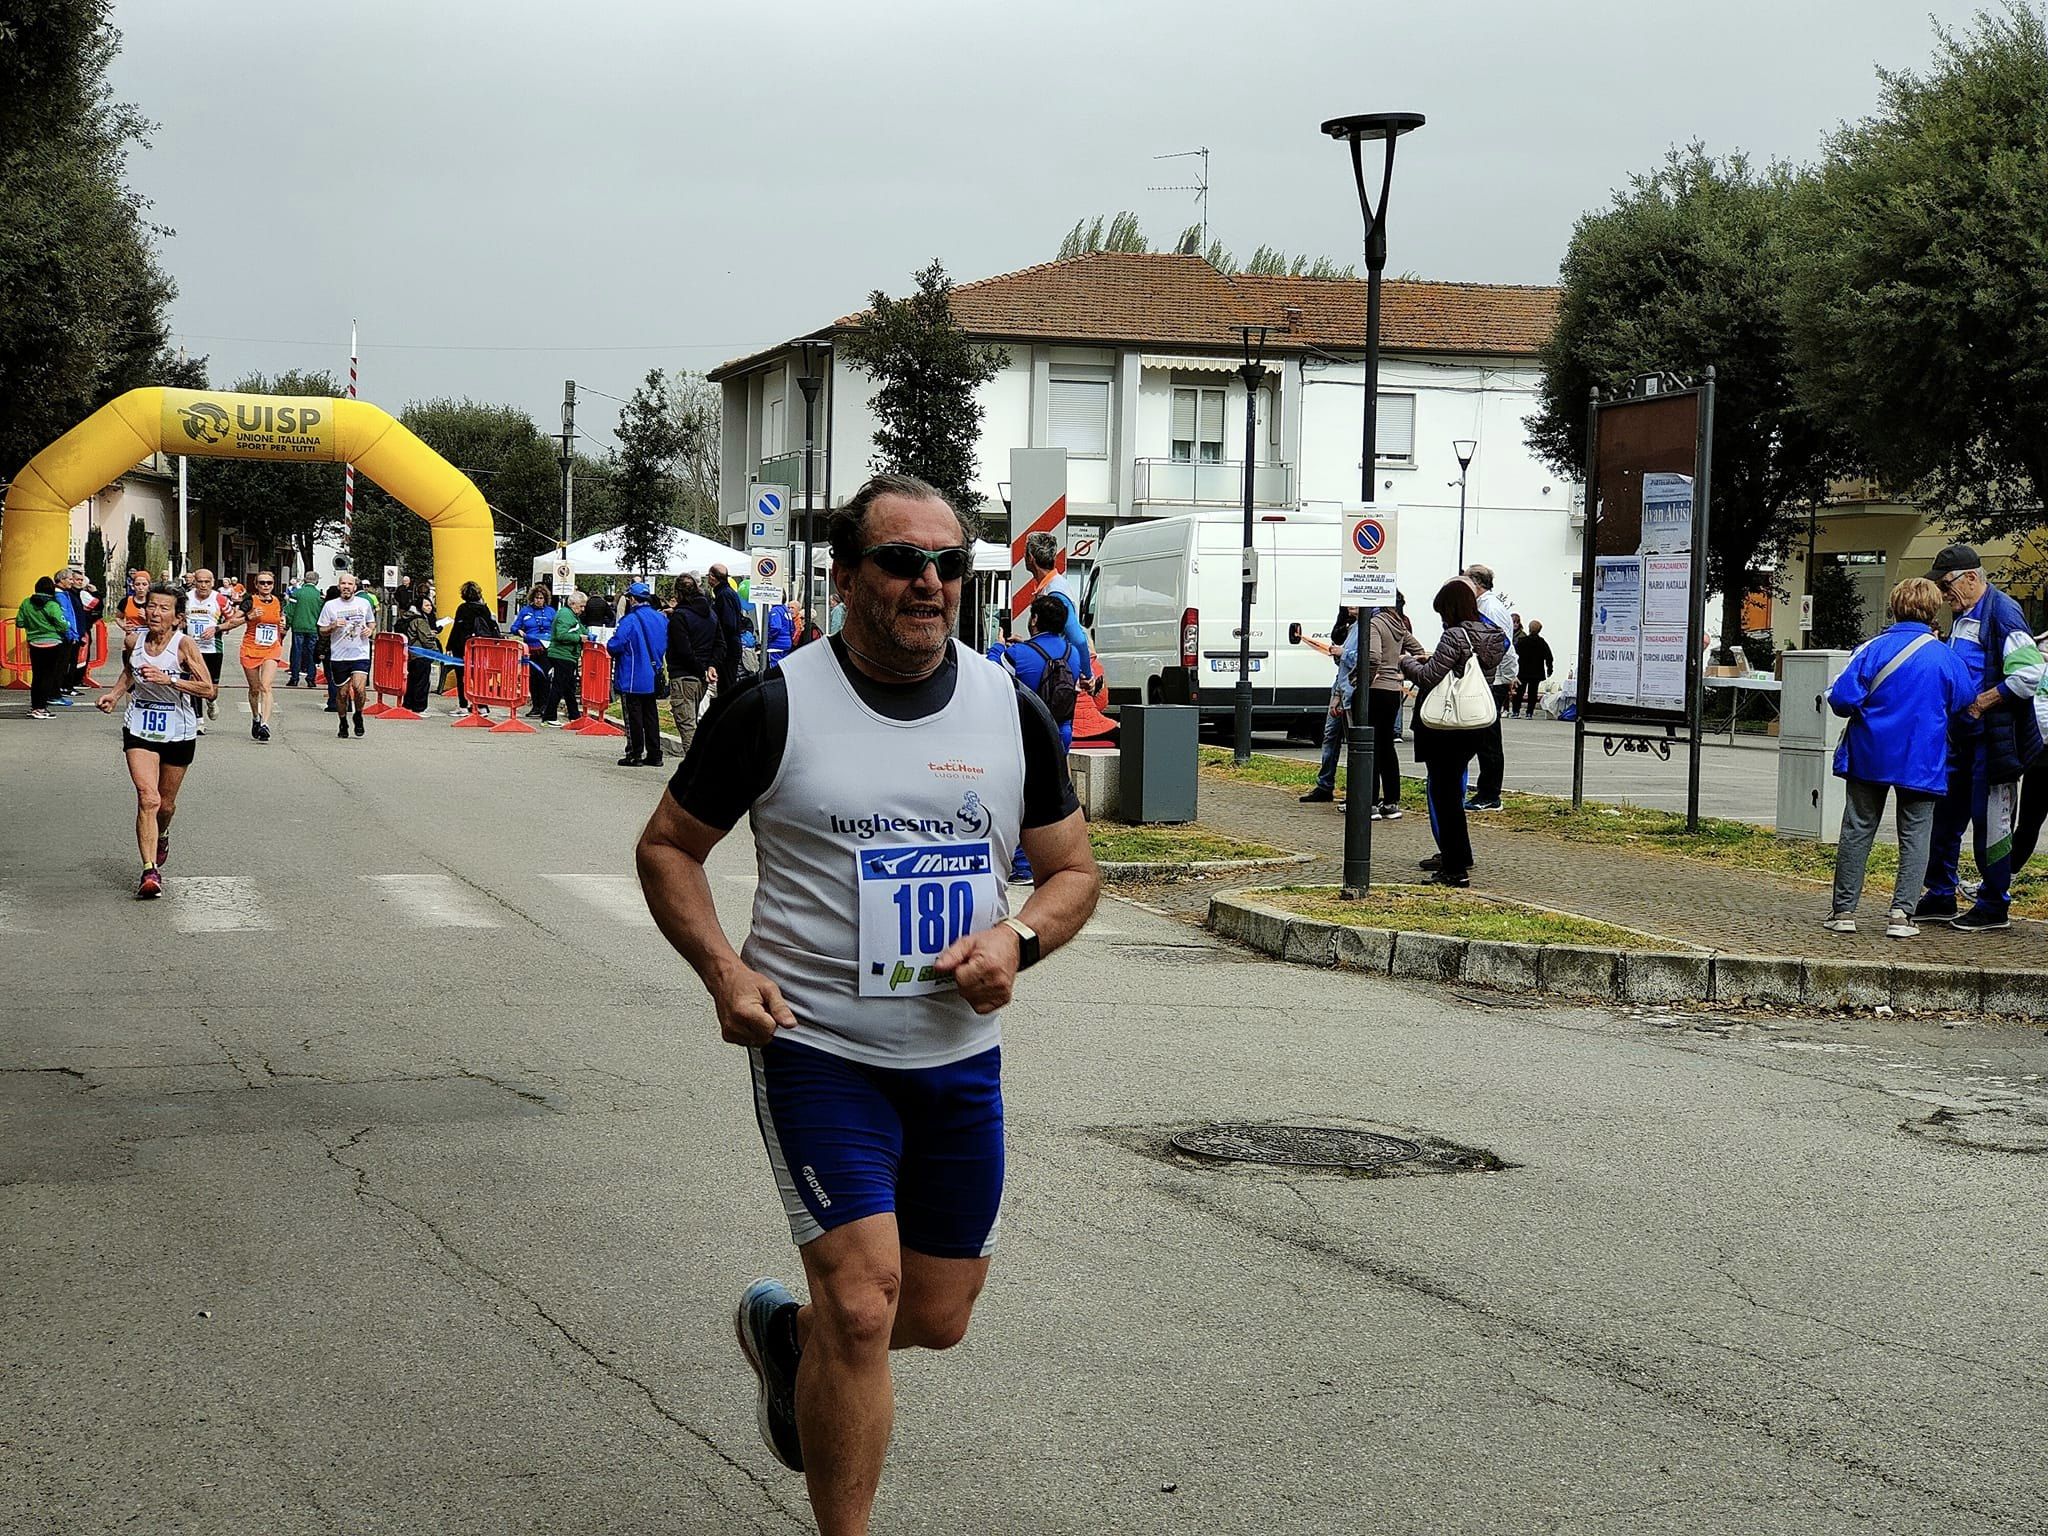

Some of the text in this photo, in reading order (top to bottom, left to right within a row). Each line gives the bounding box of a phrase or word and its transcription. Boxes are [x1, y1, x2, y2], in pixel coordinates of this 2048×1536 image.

[236, 404, 321, 434] UISP
[236, 433, 321, 445] UNIONE ITALIANA
[236, 442, 316, 453] SPORT PER TUTTI
[1645, 502, 1690, 523] Ivan Alvisi
[1666, 580, 1688, 590] NATALIA
[262, 629, 274, 641] 112
[1597, 649, 1635, 662] ALVISI IVAN
[142, 710, 167, 732] 193
[830, 814, 955, 839] lughesina
[893, 881, 974, 956] 180
